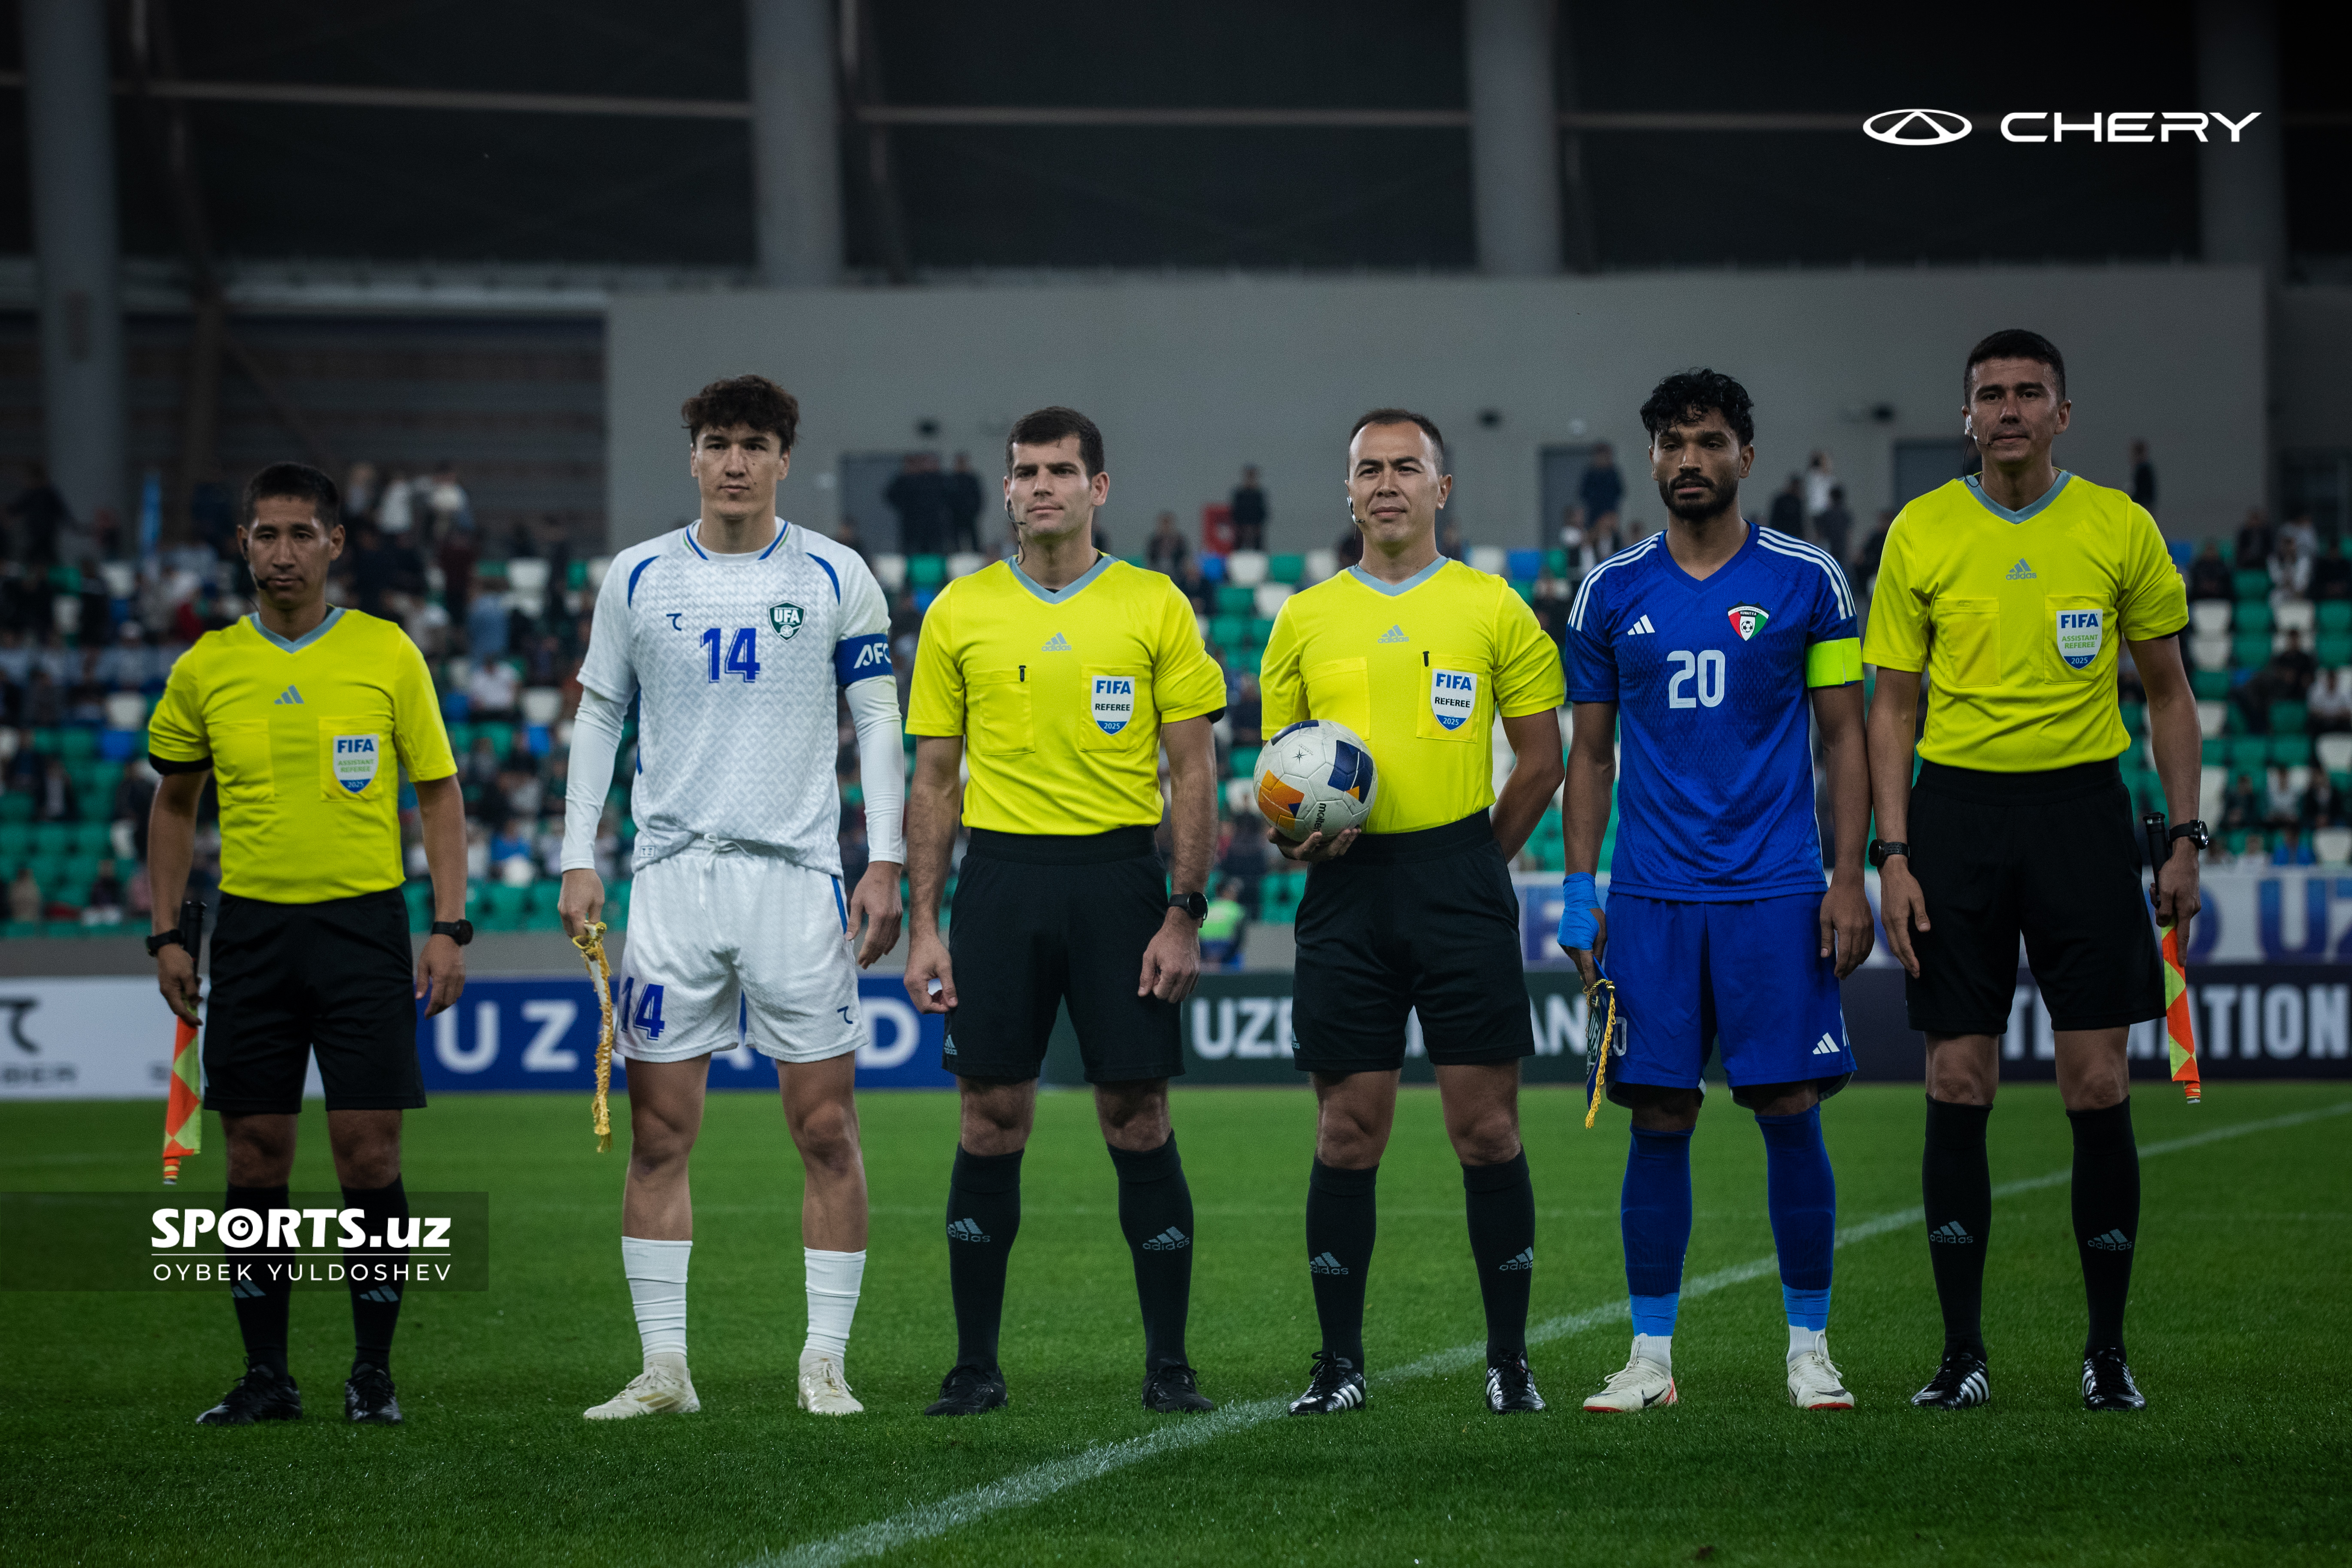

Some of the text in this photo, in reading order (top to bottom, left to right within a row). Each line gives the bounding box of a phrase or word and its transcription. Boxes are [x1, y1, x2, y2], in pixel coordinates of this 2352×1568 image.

[2005, 571, 2037, 581] adidas
[774, 609, 800, 623] UFA
[2061, 613, 2099, 628] FIFA
[700, 628, 760, 683] 14
[1436, 673, 1472, 691] FIFA
[1667, 649, 1725, 708] 20
[1096, 680, 1131, 694] FIFA
[1435, 697, 1470, 708] REFEREE
[1443, 717, 1459, 725] 2025
[338, 739, 374, 753] FIFA
[1312, 803, 1326, 831] molten
[621, 977, 665, 1040] 14
[1589, 1013, 1601, 1057] UFA
[1143, 1237, 1190, 1250] adidas
[1930, 1233, 1973, 1243] adidas
[2087, 1240, 2132, 1251] adidas
